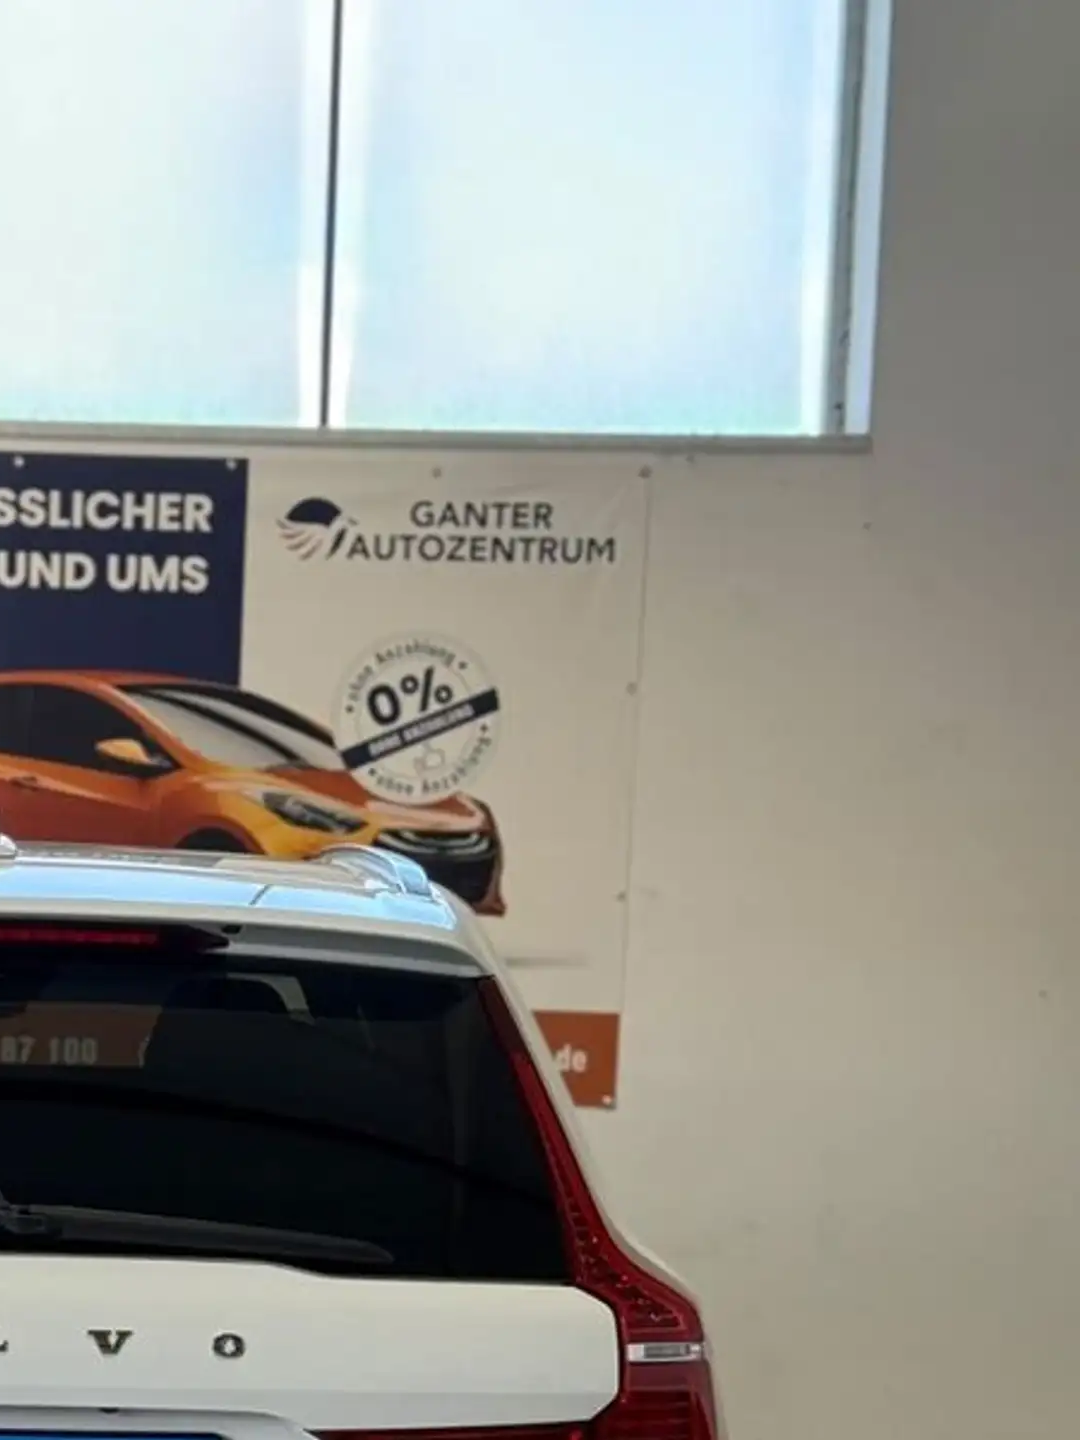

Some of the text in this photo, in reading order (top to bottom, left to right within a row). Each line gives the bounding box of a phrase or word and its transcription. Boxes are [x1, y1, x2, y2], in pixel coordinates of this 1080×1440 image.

[409, 500, 555, 531] GANTER
[346, 534, 617, 565] AUTOZENTRUM
[106, 555, 211, 593] UMS
[366, 664, 454, 727] 0%
[49, 1036, 98, 1065] 100
